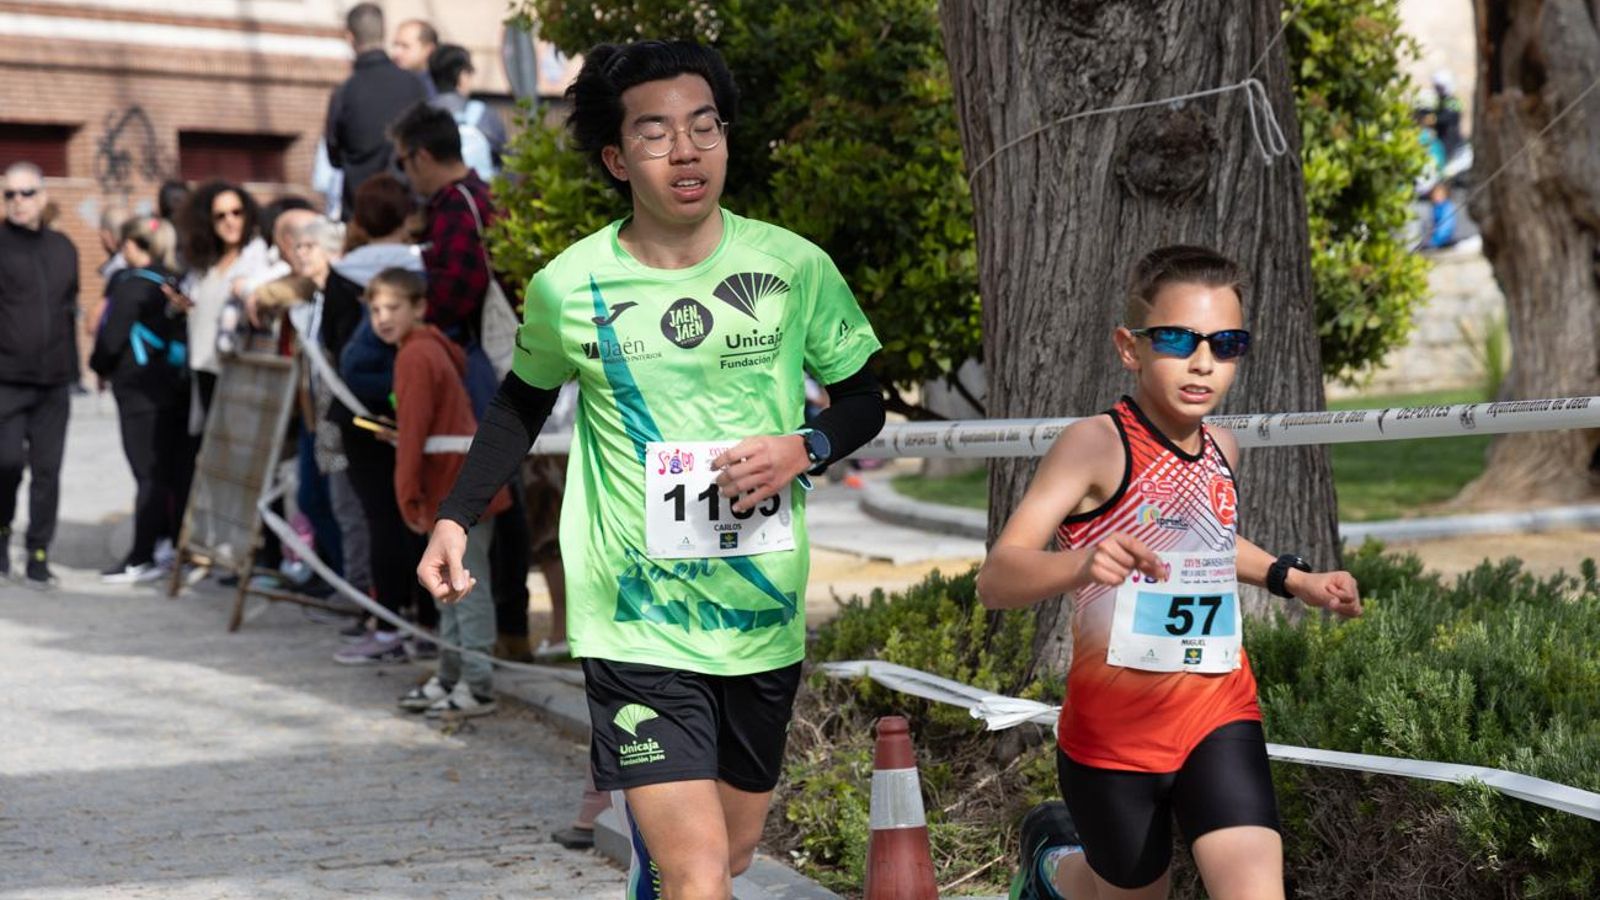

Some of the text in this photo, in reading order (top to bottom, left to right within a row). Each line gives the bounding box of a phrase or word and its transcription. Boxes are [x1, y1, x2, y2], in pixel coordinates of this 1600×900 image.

[602, 336, 645, 357] Jaén
[720, 356, 770, 369] Fundación
[714, 523, 742, 531] CARLOS
[1165, 596, 1222, 636] 57
[620, 737, 660, 755] Unicaja
